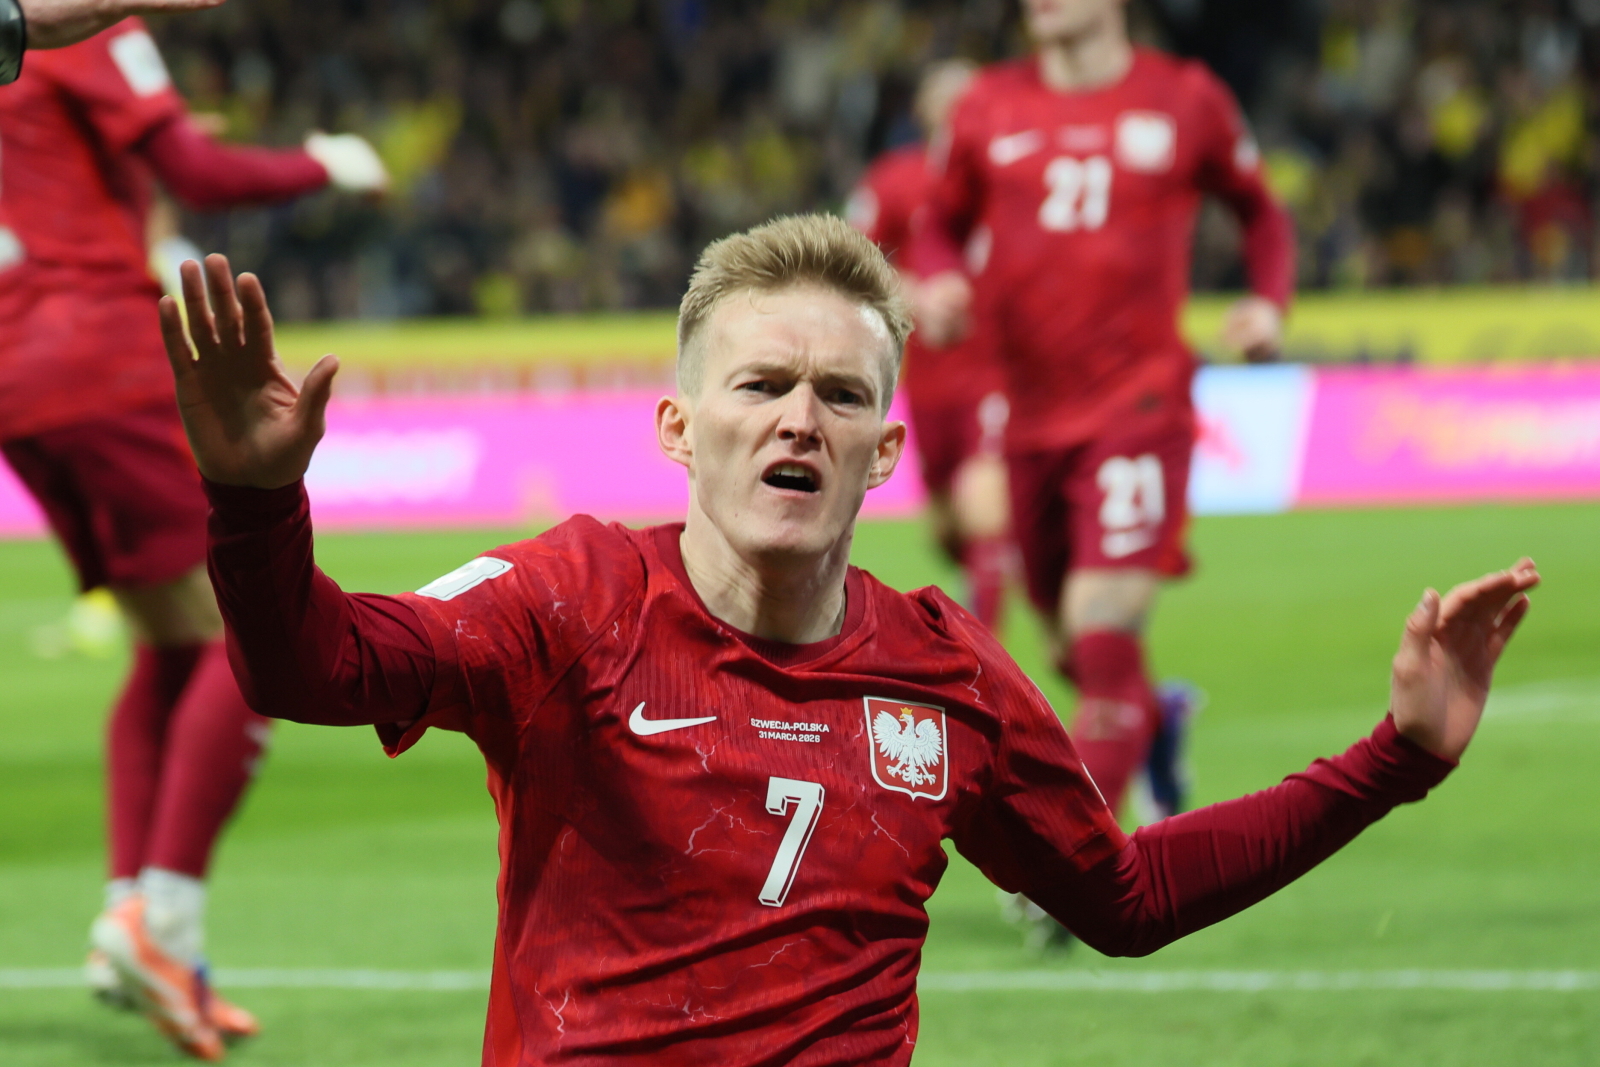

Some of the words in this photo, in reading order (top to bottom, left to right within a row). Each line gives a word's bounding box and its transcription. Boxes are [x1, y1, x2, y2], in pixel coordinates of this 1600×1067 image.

[1039, 155, 1112, 232] 21
[1096, 453, 1165, 529] 21
[750, 718, 830, 733] SZWECJA-POLSKA
[758, 730, 767, 739] 31
[768, 731, 798, 741] MARCA
[798, 734, 821, 743] 2026
[758, 776, 825, 907] 7
